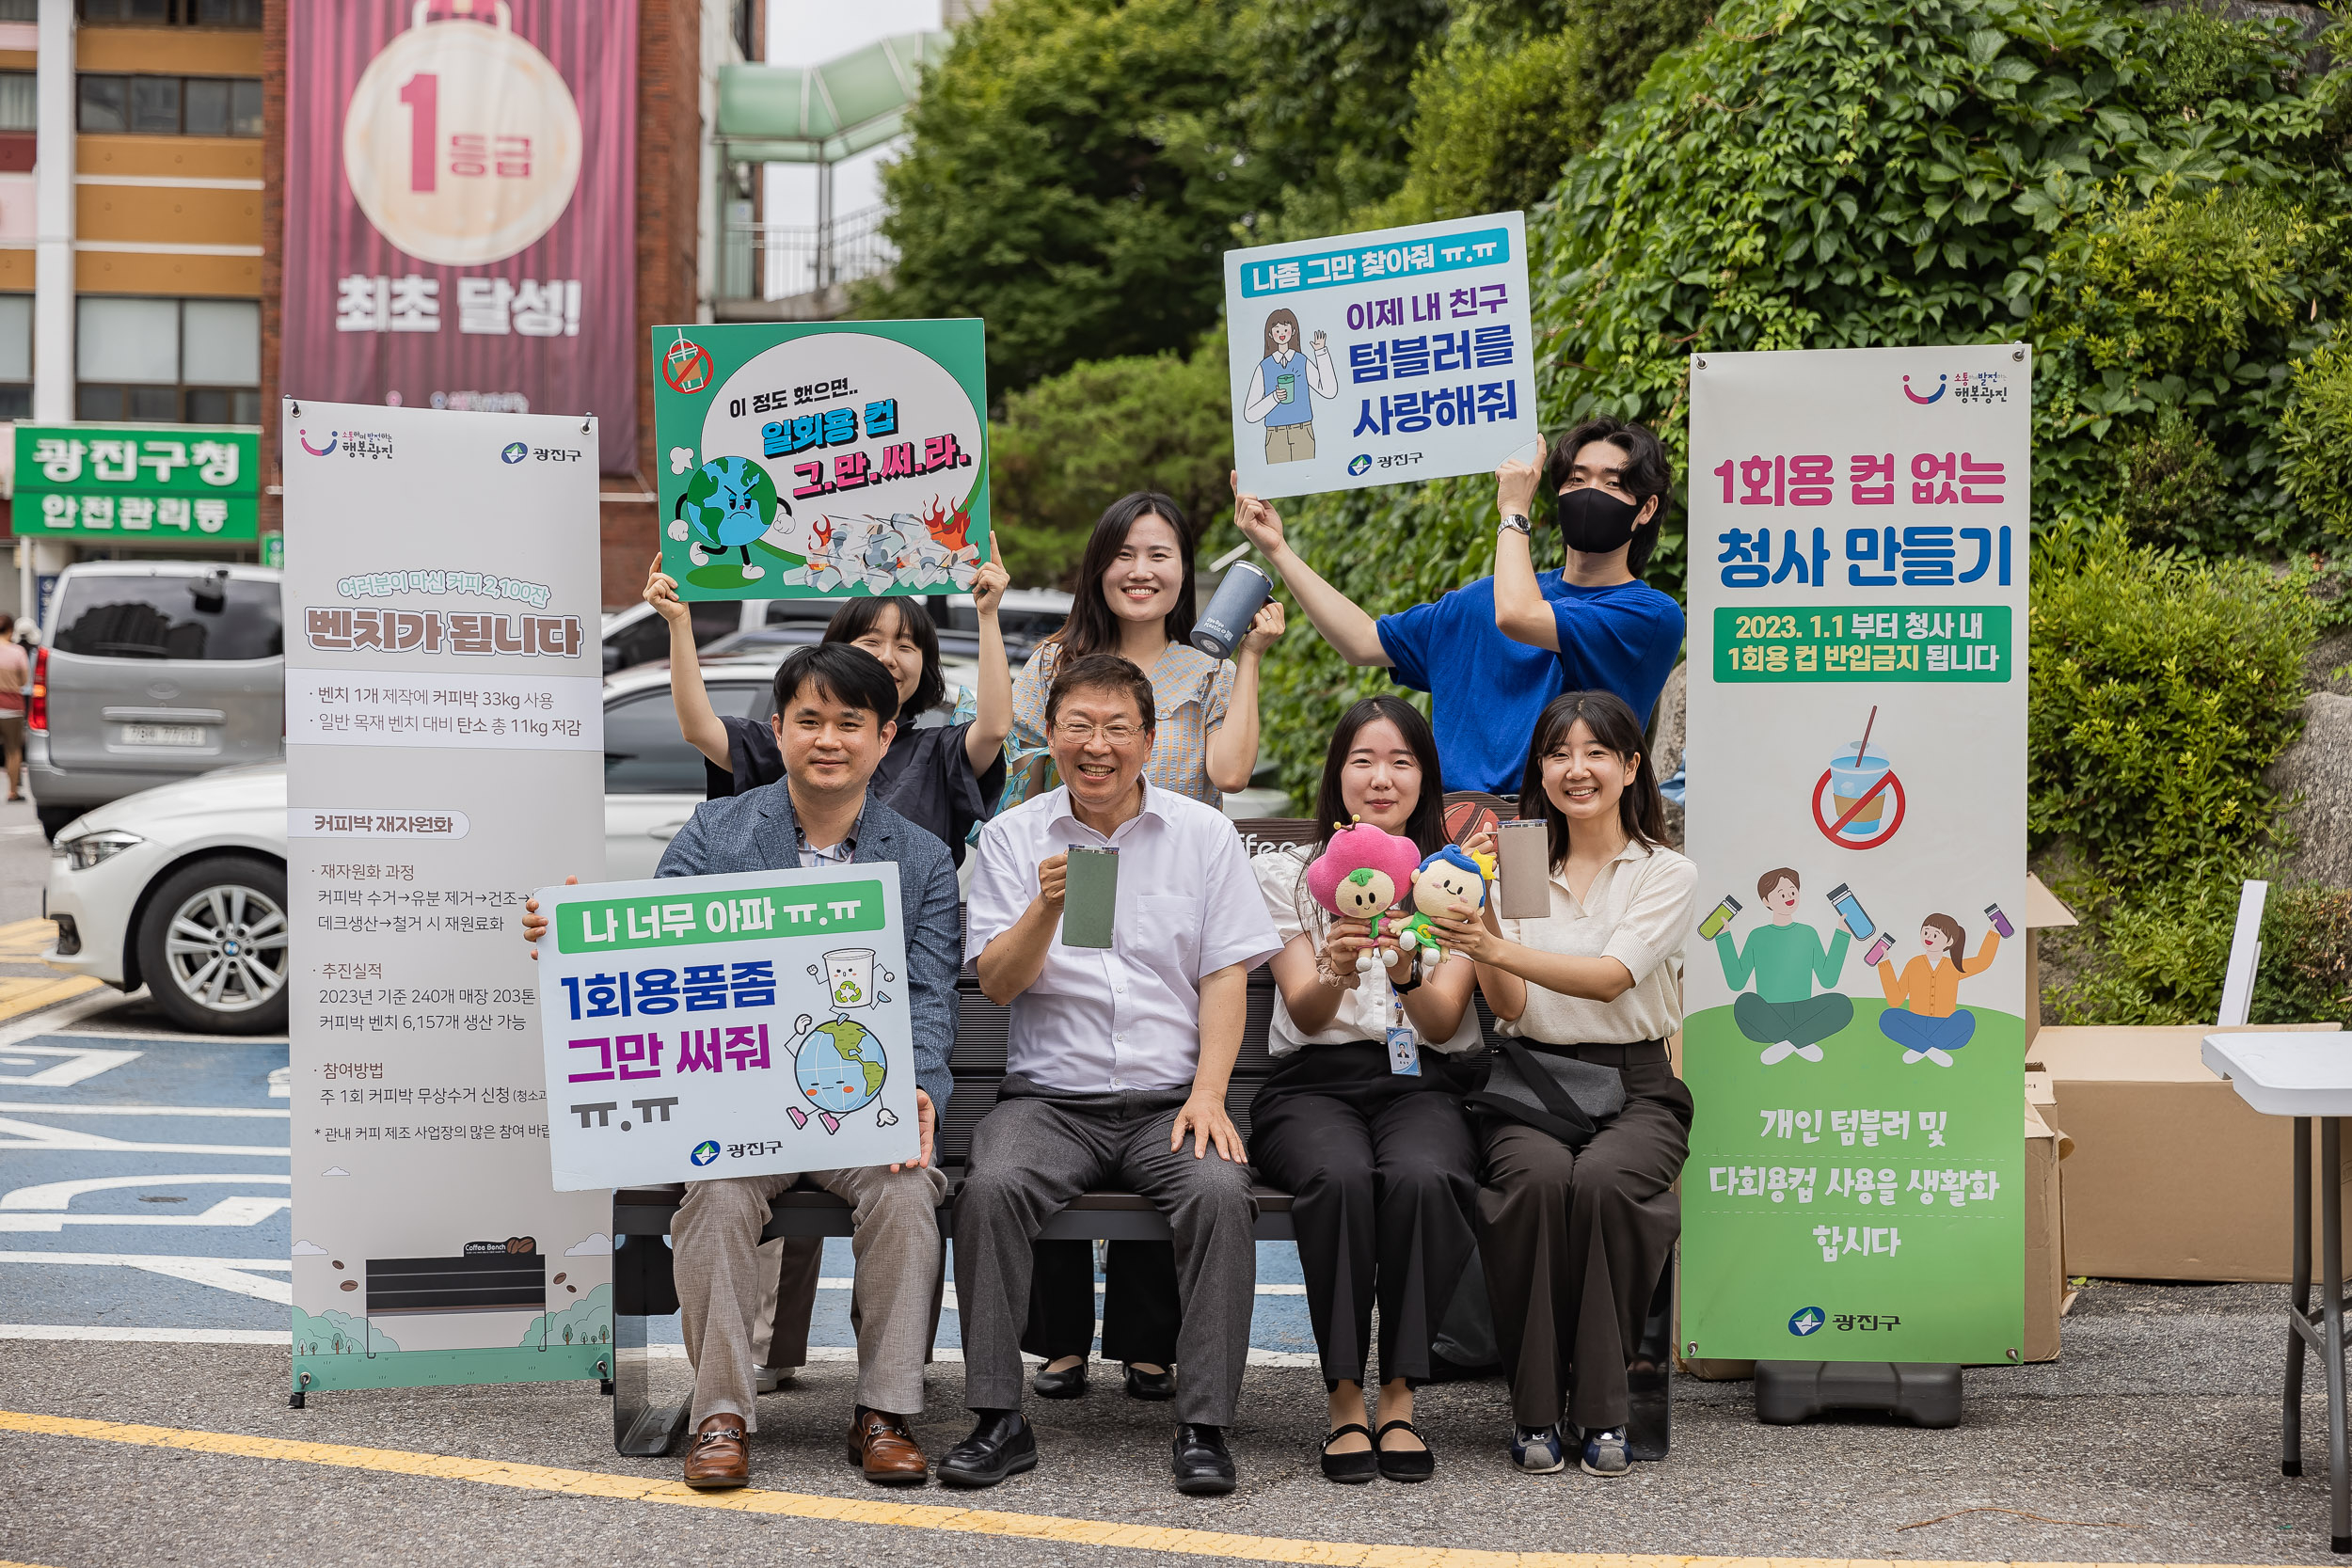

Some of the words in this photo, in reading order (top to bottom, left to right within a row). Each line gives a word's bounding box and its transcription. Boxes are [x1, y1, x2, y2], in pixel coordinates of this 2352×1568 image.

[399, 71, 533, 194] 1등급
[1252, 262, 1301, 292] 나좀
[1307, 255, 1356, 284] 그만
[1361, 244, 1435, 276] 찾아줘
[336, 274, 441, 334] 최초
[456, 276, 583, 337] 달성!
[1346, 297, 1404, 330] 이제
[1412, 293, 1440, 322] 내
[1450, 283, 1508, 318] 친구
[1348, 325, 1515, 384] 텀블러를
[1954, 372, 1978, 386] 소통
[1979, 372, 2008, 386] 발전
[1954, 385, 2007, 404] 행복광진
[729, 398, 746, 418] 이
[753, 388, 787, 414] 정도
[794, 378, 858, 404] 했으면..
[1353, 379, 1518, 438] 사랑해줘
[761, 407, 857, 458] 일회용
[864, 399, 898, 438] 컵
[33, 438, 239, 486] 광진구청
[342, 440, 393, 460] 행복광진
[533, 448, 582, 463] 광진구
[1376, 451, 1423, 468] 광진구
[793, 434, 972, 499] 그.만.써.라.
[1713, 454, 1835, 506] 1회용
[1850, 453, 1895, 505] 컵
[1911, 451, 2006, 505] 없는
[42, 494, 228, 533] 안전관리동
[1718, 527, 1831, 588] 청사
[1846, 526, 2011, 586] 만들기
[410, 571, 444, 593] 마신
[448, 573, 481, 594] 커피
[484, 578, 548, 606] 2,100잔
[307, 609, 444, 652] 벤치가
[448, 613, 582, 657] 됩니다
[1736, 616, 1803, 639] 2023.
[1810, 615, 1843, 638] 1.1
[1851, 613, 1898, 640] 부터
[1905, 612, 1954, 640] 청사
[1959, 612, 1983, 640] 내
[1728, 645, 1788, 672] 1회용
[1794, 645, 1818, 673] 컵
[1824, 644, 1919, 672] 반입금지
[1926, 645, 1999, 673] 됩니다
[318, 687, 349, 705] 벤치
[354, 687, 378, 705] 1개
[382, 688, 428, 706] 제작에
[433, 689, 478, 707] 커피박
[483, 692, 520, 709] 33kg
[524, 691, 554, 710] 사용
[319, 713, 350, 731] 일반
[354, 714, 384, 733] 목재
[388, 715, 419, 734] 벤치
[422, 716, 453, 734] 대비
[457, 717, 487, 734] 탄소
[491, 718, 507, 736] 총
[511, 720, 548, 737] 11kg
[551, 719, 581, 737] 저감
[314, 815, 373, 832] 커피박
[375, 816, 453, 834] 재자원화
[321, 864, 381, 880] 재자원화
[385, 865, 415, 881] 과정
[318, 890, 363, 906] 커피박
[426, 916, 440, 932] 시
[444, 916, 504, 932] 재원료화
[582, 907, 618, 942] 나
[627, 902, 697, 940] 너무
[706, 896, 775, 933] 아파
[322, 963, 383, 979] 추진실적
[319, 990, 373, 1005] 2023년
[378, 990, 407, 1006] 기준
[411, 989, 455, 1005] 240개
[459, 989, 489, 1005] 매장
[493, 989, 535, 1005] 203톤
[560, 959, 777, 1021] 1회용품좀
[319, 1015, 365, 1031] 커피박
[369, 1015, 398, 1031] 벤치
[402, 1015, 459, 1031] 6,157개
[463, 1015, 493, 1031] 생산
[498, 1014, 527, 1031] 가능
[567, 1032, 663, 1084] 그만
[675, 1023, 771, 1075] 써줘
[323, 1063, 383, 1080] 참여방법
[320, 1089, 335, 1105] 주
[340, 1089, 363, 1104] 1회
[368, 1088, 413, 1104] 커피박
[417, 1087, 476, 1104] 무상수거
[481, 1087, 510, 1103] 신청
[325, 1128, 351, 1142] 관내
[355, 1128, 381, 1141] 커피
[384, 1127, 411, 1141] 제조
[415, 1126, 467, 1141] 사업장의
[470, 1126, 496, 1140] 많은
[500, 1124, 524, 1139] 참여
[1759, 1108, 1822, 1144] 개인
[1830, 1109, 1911, 1147] 텀블러
[1918, 1111, 1947, 1148] 및
[726, 1140, 784, 1159] 광진구
[1708, 1165, 1817, 1204] 다회용컵
[1825, 1167, 1898, 1206] 사용을
[1905, 1168, 2000, 1207] 생활화
[1813, 1225, 1901, 1262] 합시다
[1833, 1314, 1901, 1332] 광진구
